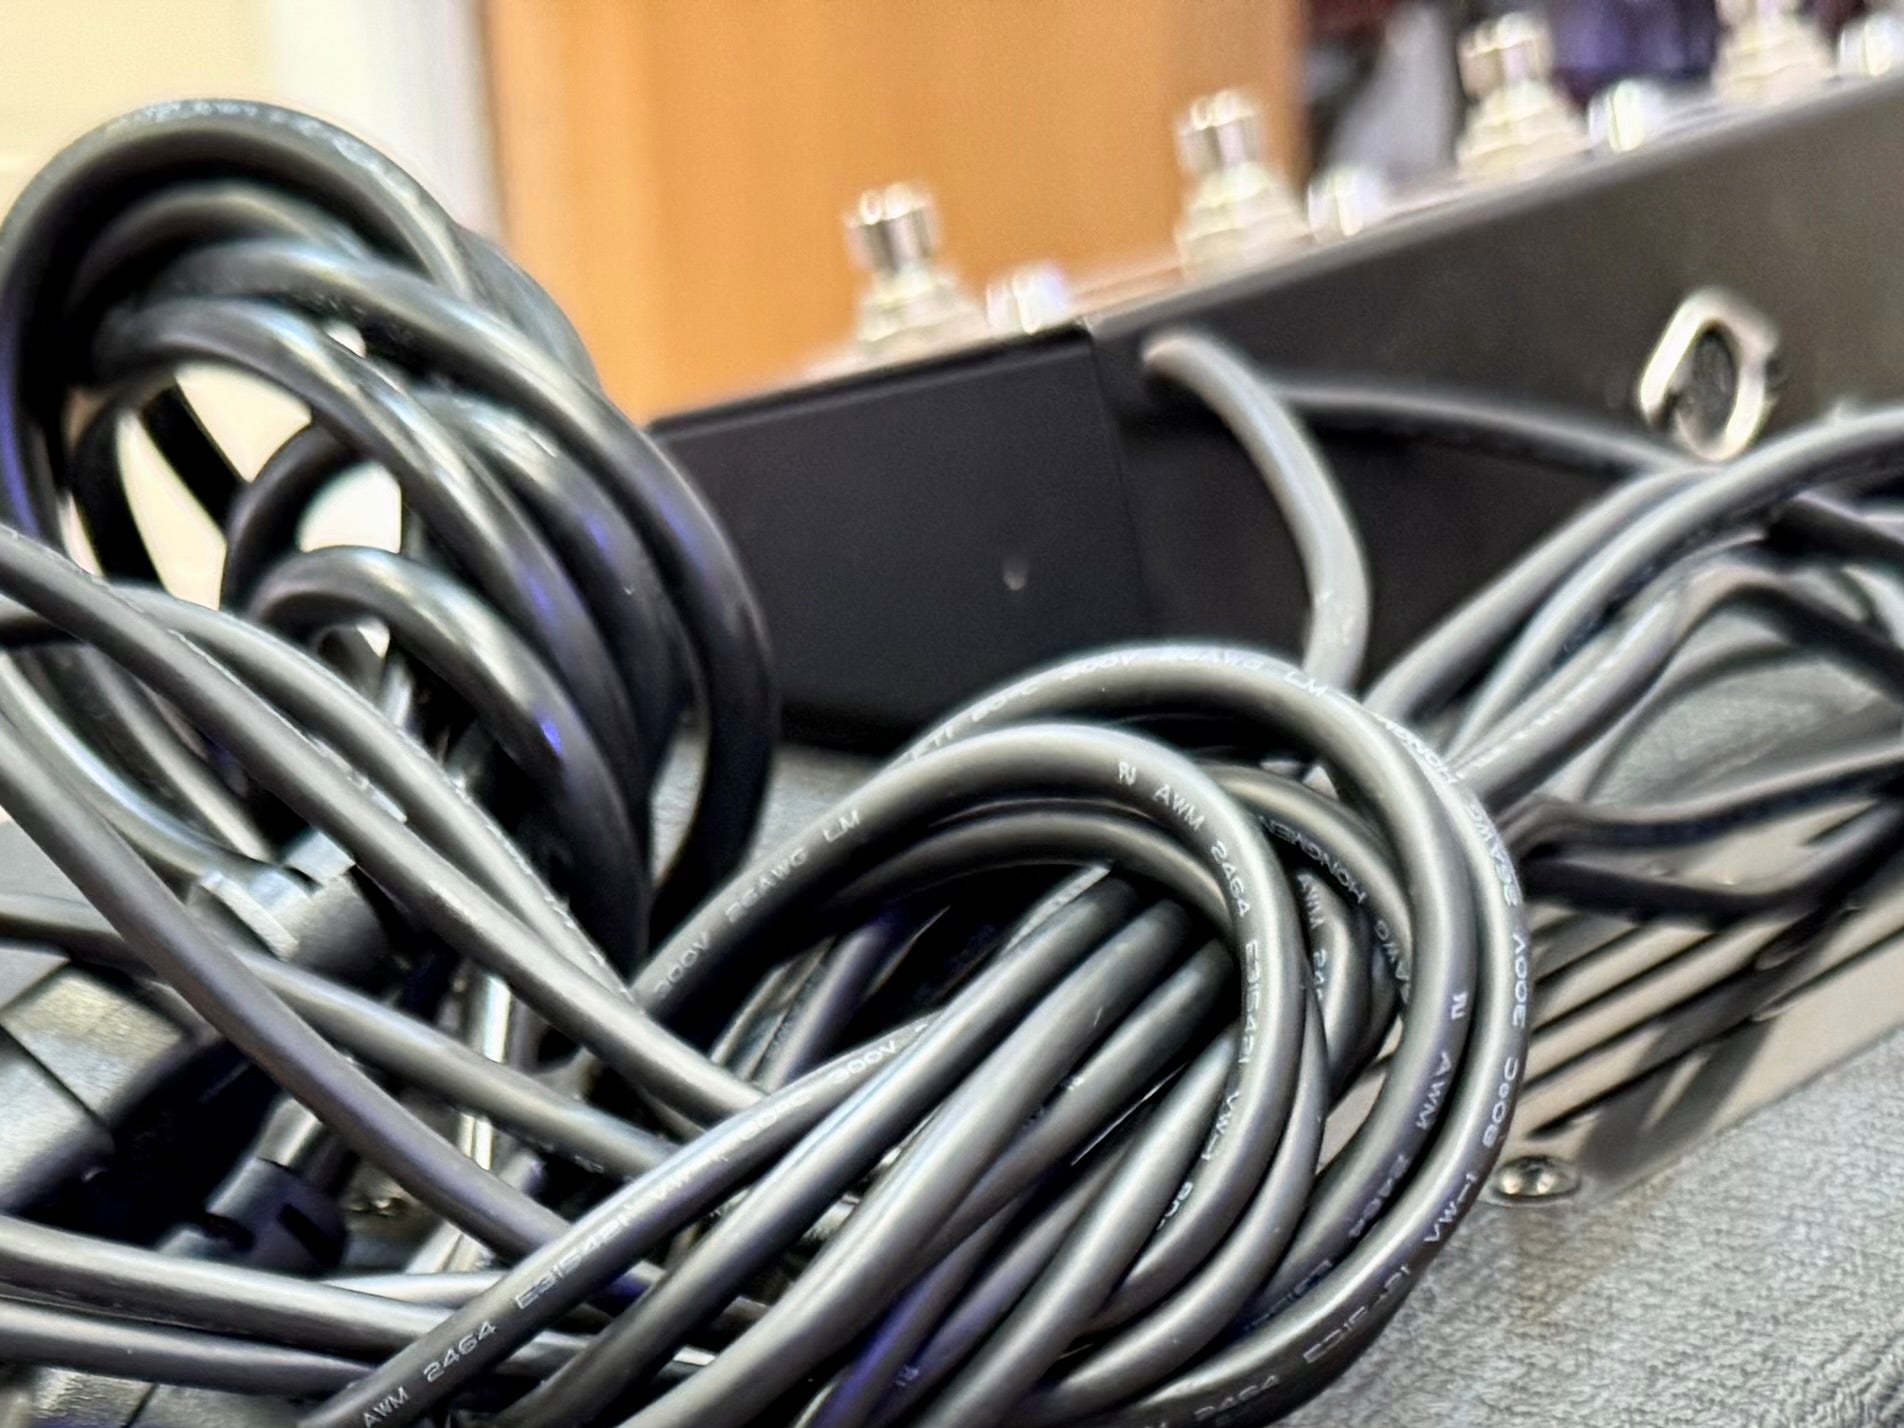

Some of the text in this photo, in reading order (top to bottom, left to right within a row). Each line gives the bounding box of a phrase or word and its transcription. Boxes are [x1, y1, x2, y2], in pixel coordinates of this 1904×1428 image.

[822, 809, 861, 843] LM
[1152, 783, 1205, 832] AWM
[1210, 840, 1251, 918] 2464
[1512, 932, 1528, 1029] 300V
[363, 1386, 408, 1428] AWM
[422, 1319, 496, 1383] 2464
[825, 1039, 899, 1085] 300V
